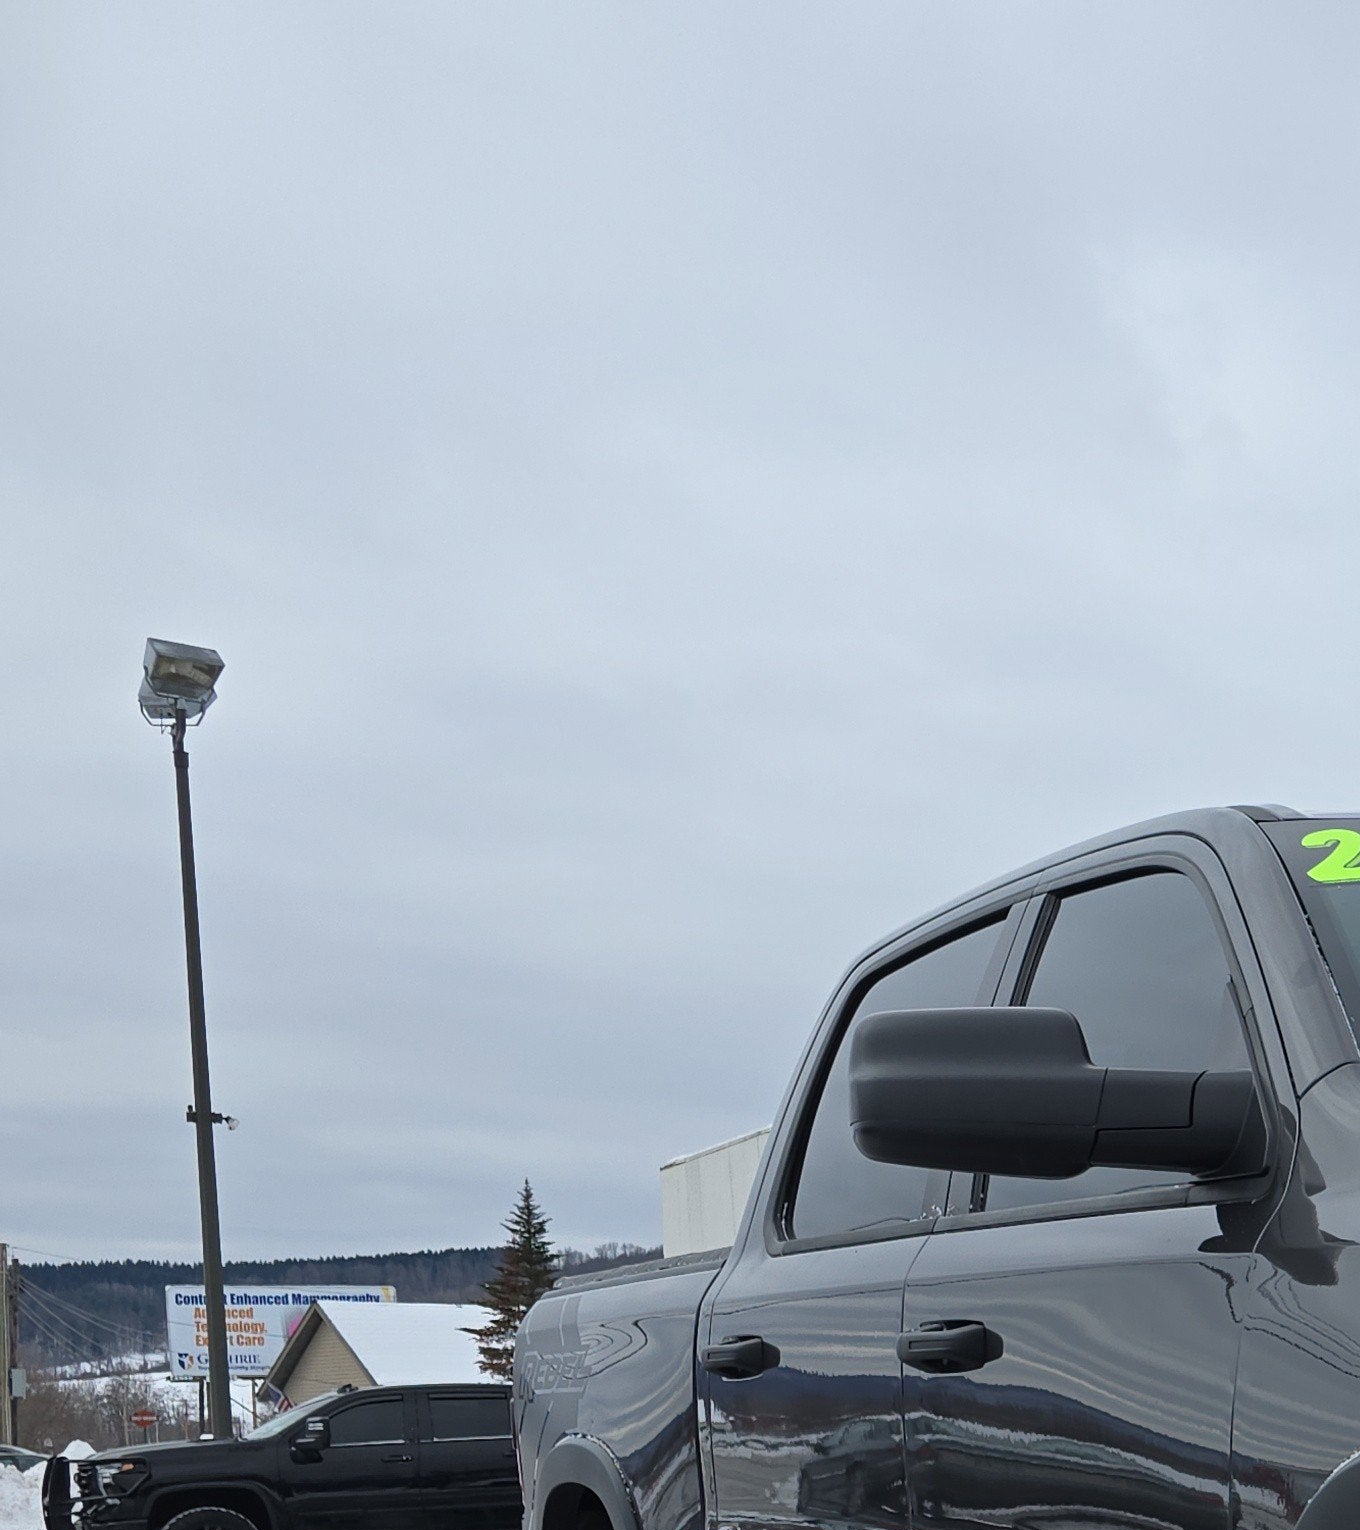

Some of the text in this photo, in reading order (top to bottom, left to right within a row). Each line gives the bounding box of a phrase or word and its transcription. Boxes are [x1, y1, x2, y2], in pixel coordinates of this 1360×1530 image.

[230, 1293, 289, 1306] Enhanced
[236, 1334, 265, 1347] Care
[197, 1353, 261, 1365] GHRIE
